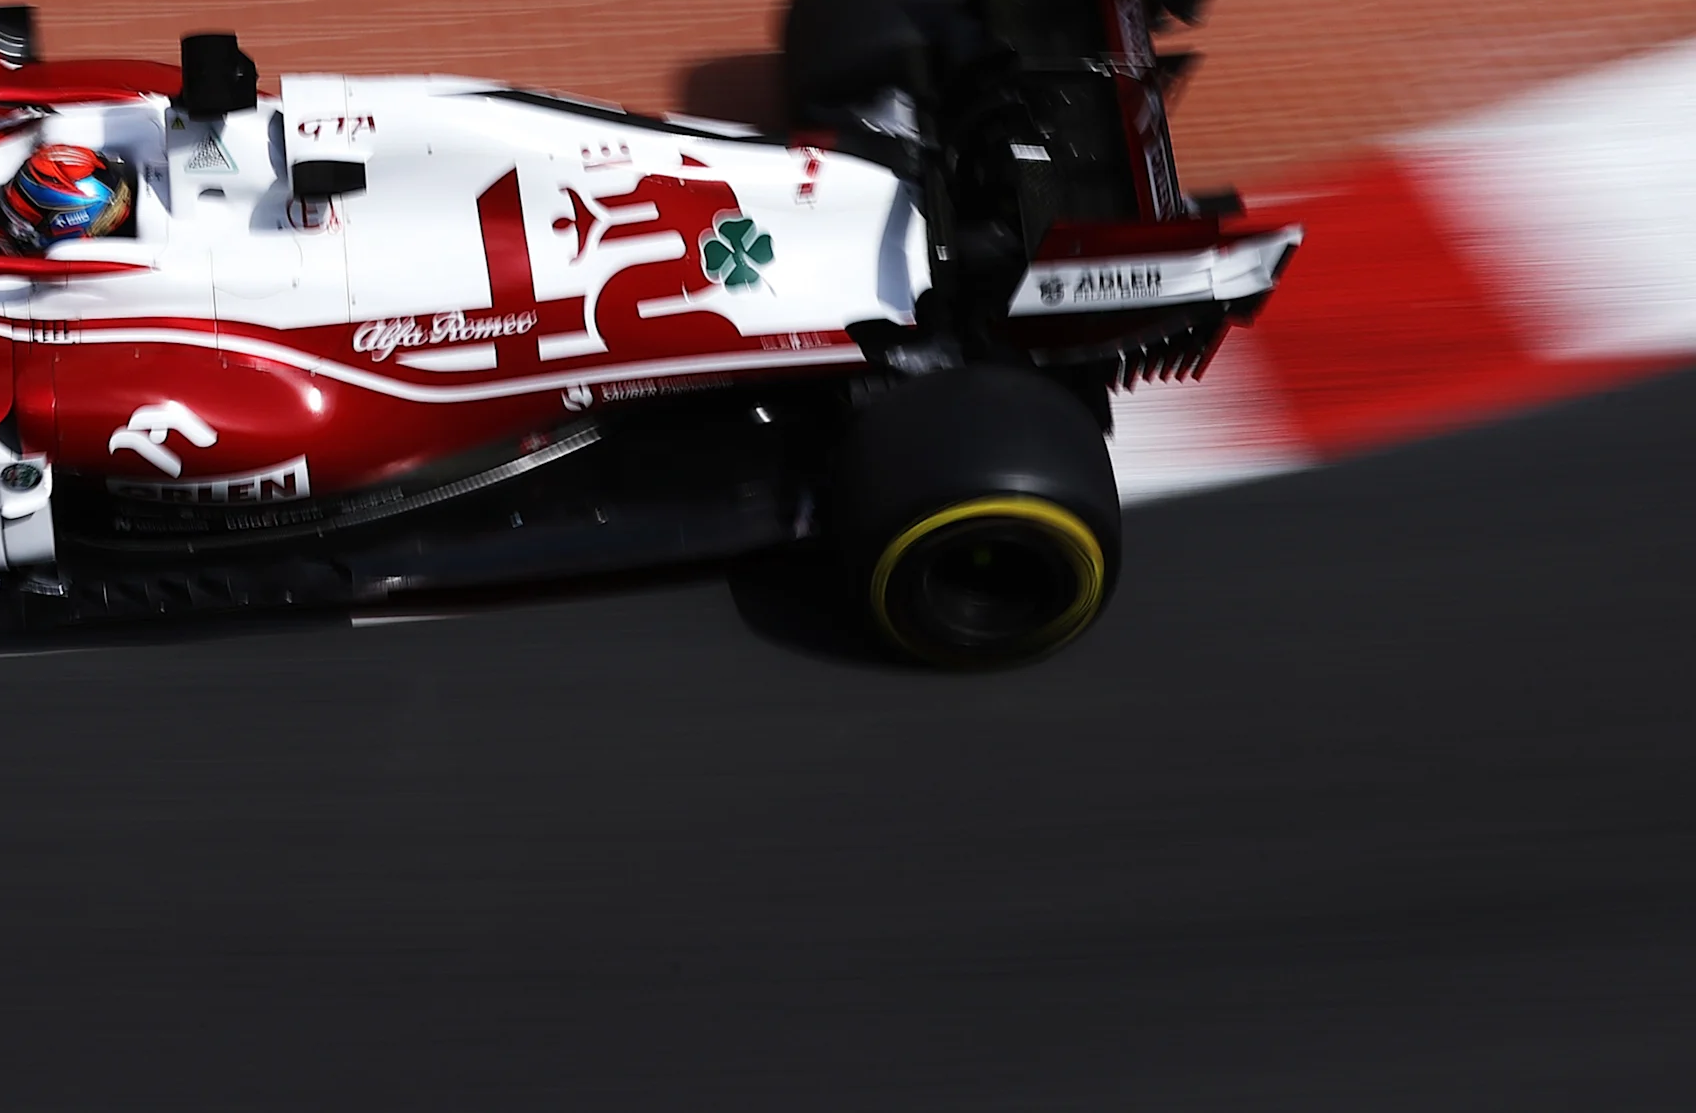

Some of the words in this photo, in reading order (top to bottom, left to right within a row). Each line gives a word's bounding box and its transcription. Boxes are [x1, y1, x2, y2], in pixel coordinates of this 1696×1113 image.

[353, 317, 428, 362] Alfa
[428, 309, 538, 344] Romeo
[115, 464, 298, 504] ORLEN
